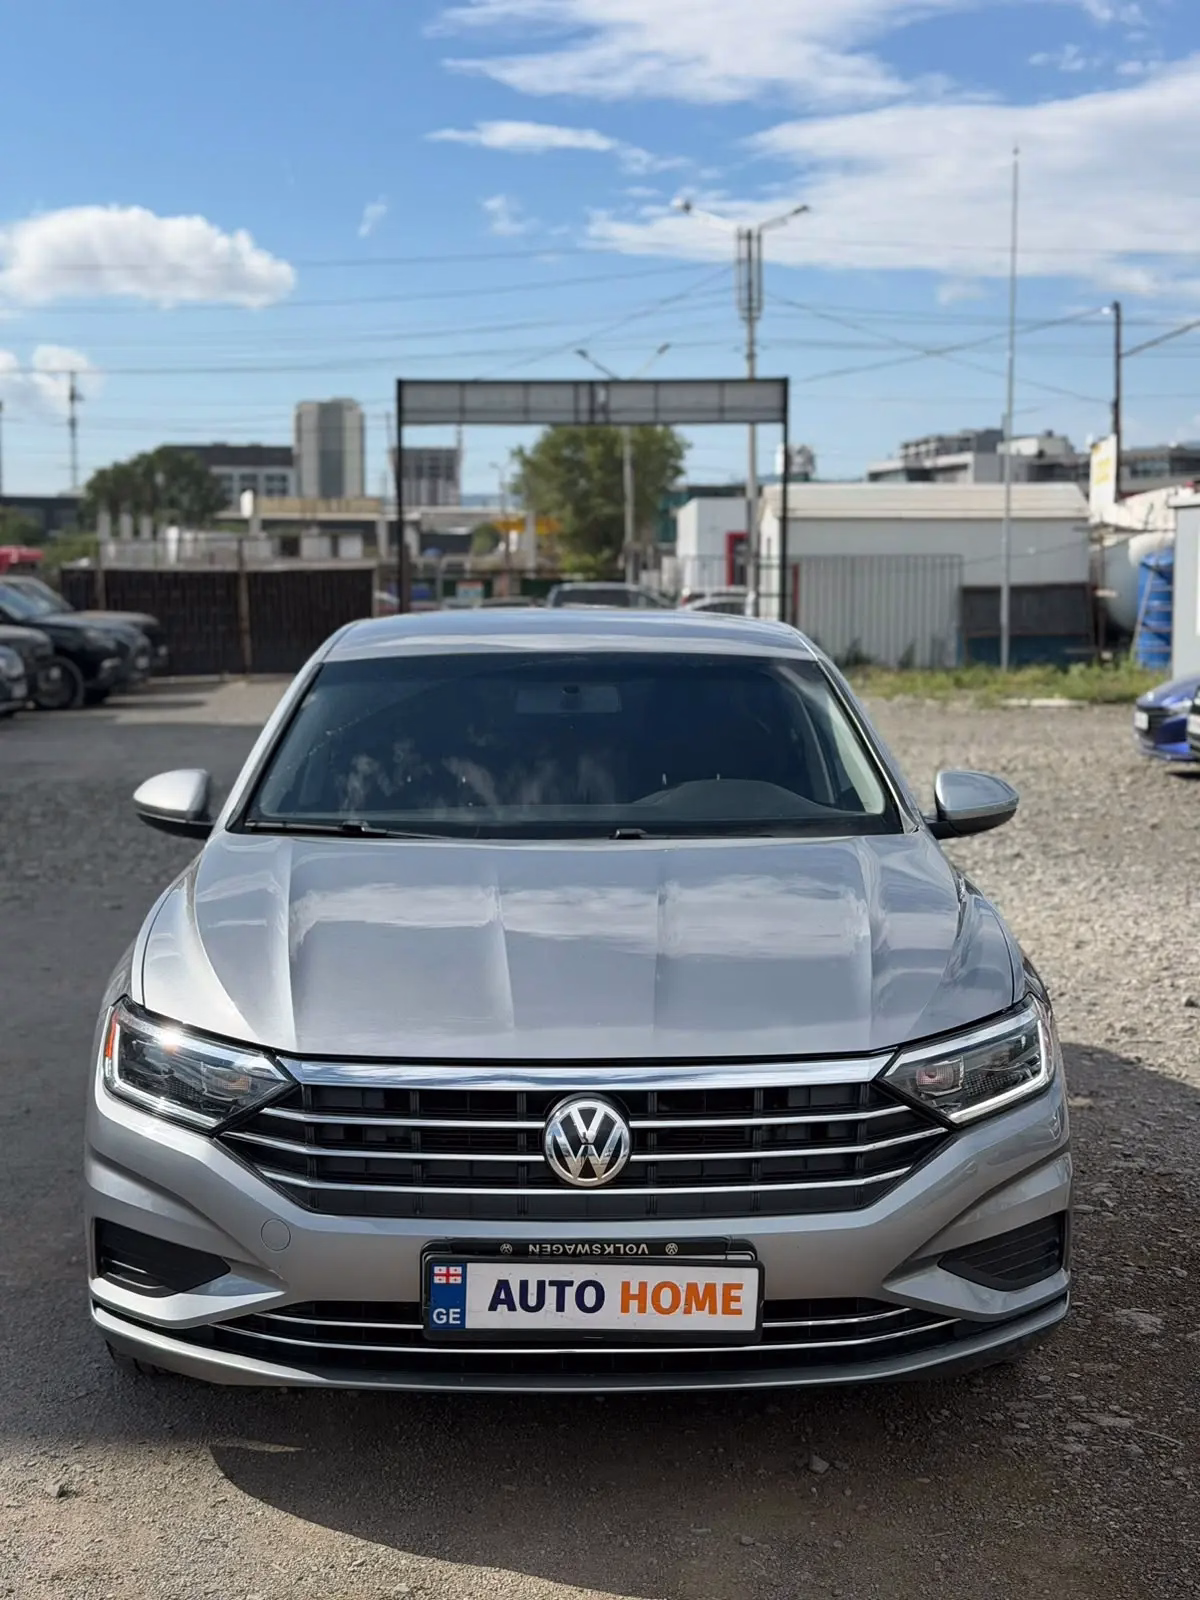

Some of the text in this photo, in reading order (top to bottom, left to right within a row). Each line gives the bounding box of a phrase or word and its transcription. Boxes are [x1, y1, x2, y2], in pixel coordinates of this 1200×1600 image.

[549, 1101, 626, 1184] VW
[528, 1243, 649, 1255] VOLKSWAGEN
[487, 1278, 744, 1316] AUTO HOME
[432, 1308, 461, 1325] GE
